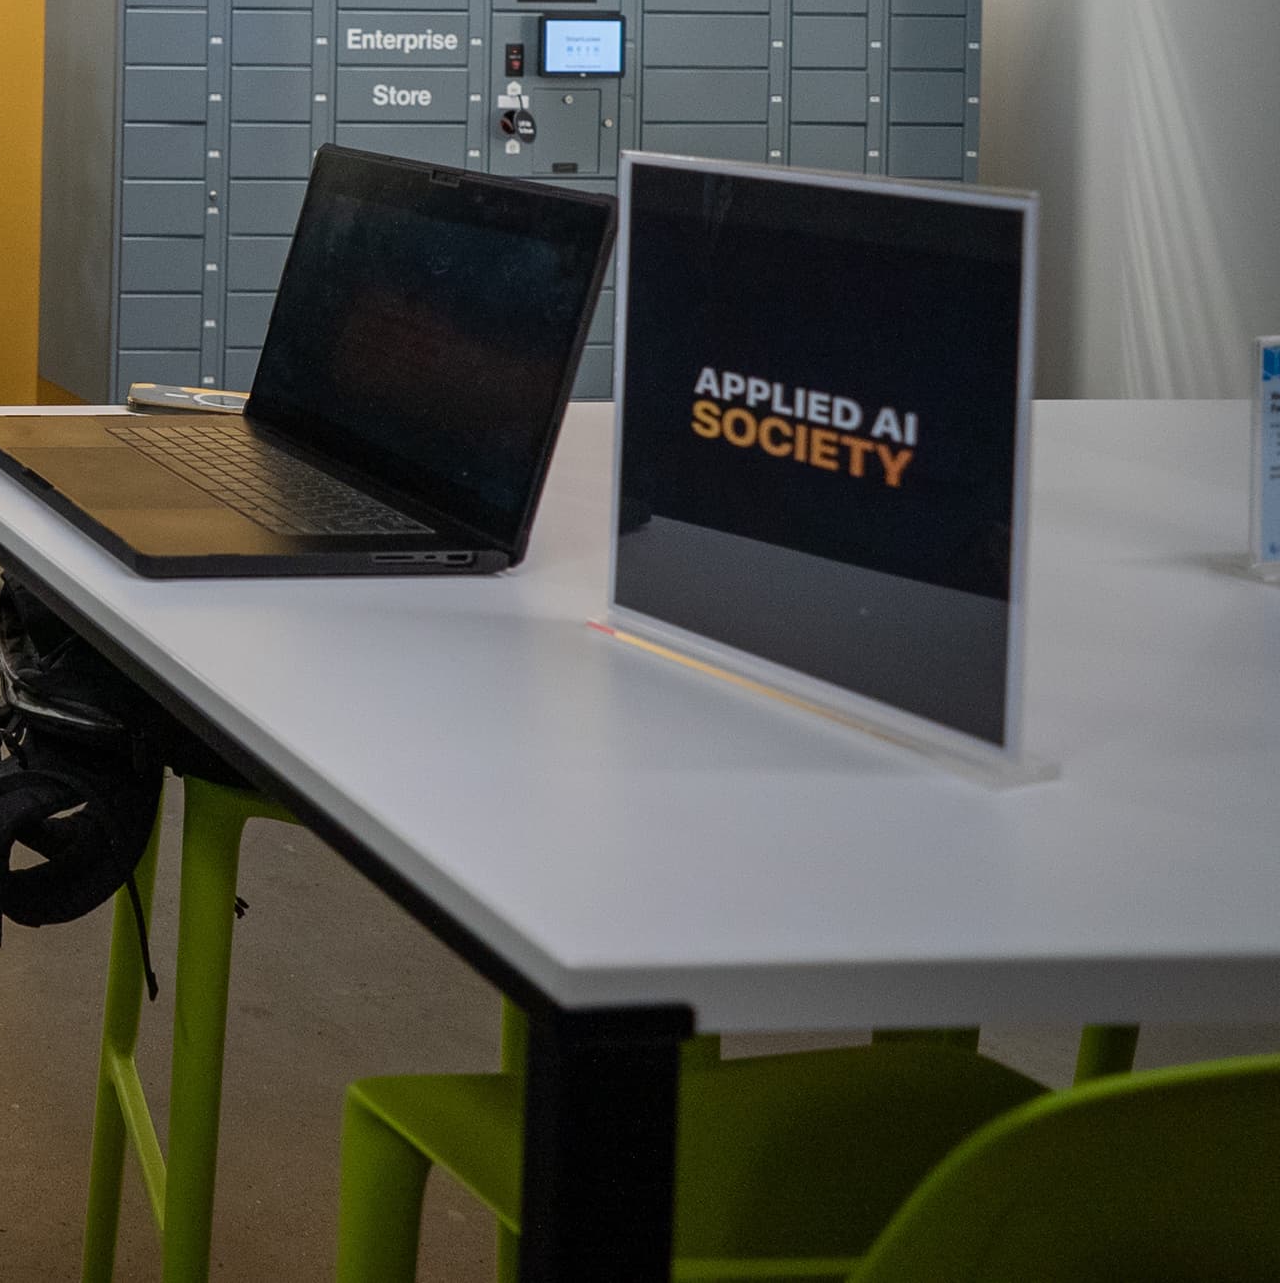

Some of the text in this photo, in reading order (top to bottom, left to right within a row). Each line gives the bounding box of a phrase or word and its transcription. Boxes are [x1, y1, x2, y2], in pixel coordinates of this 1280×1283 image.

[347, 28, 458, 54] Enterprise
[372, 84, 432, 106] Store
[694, 366, 919, 447] APPLIED AI
[691, 399, 914, 488] SOCIETY
